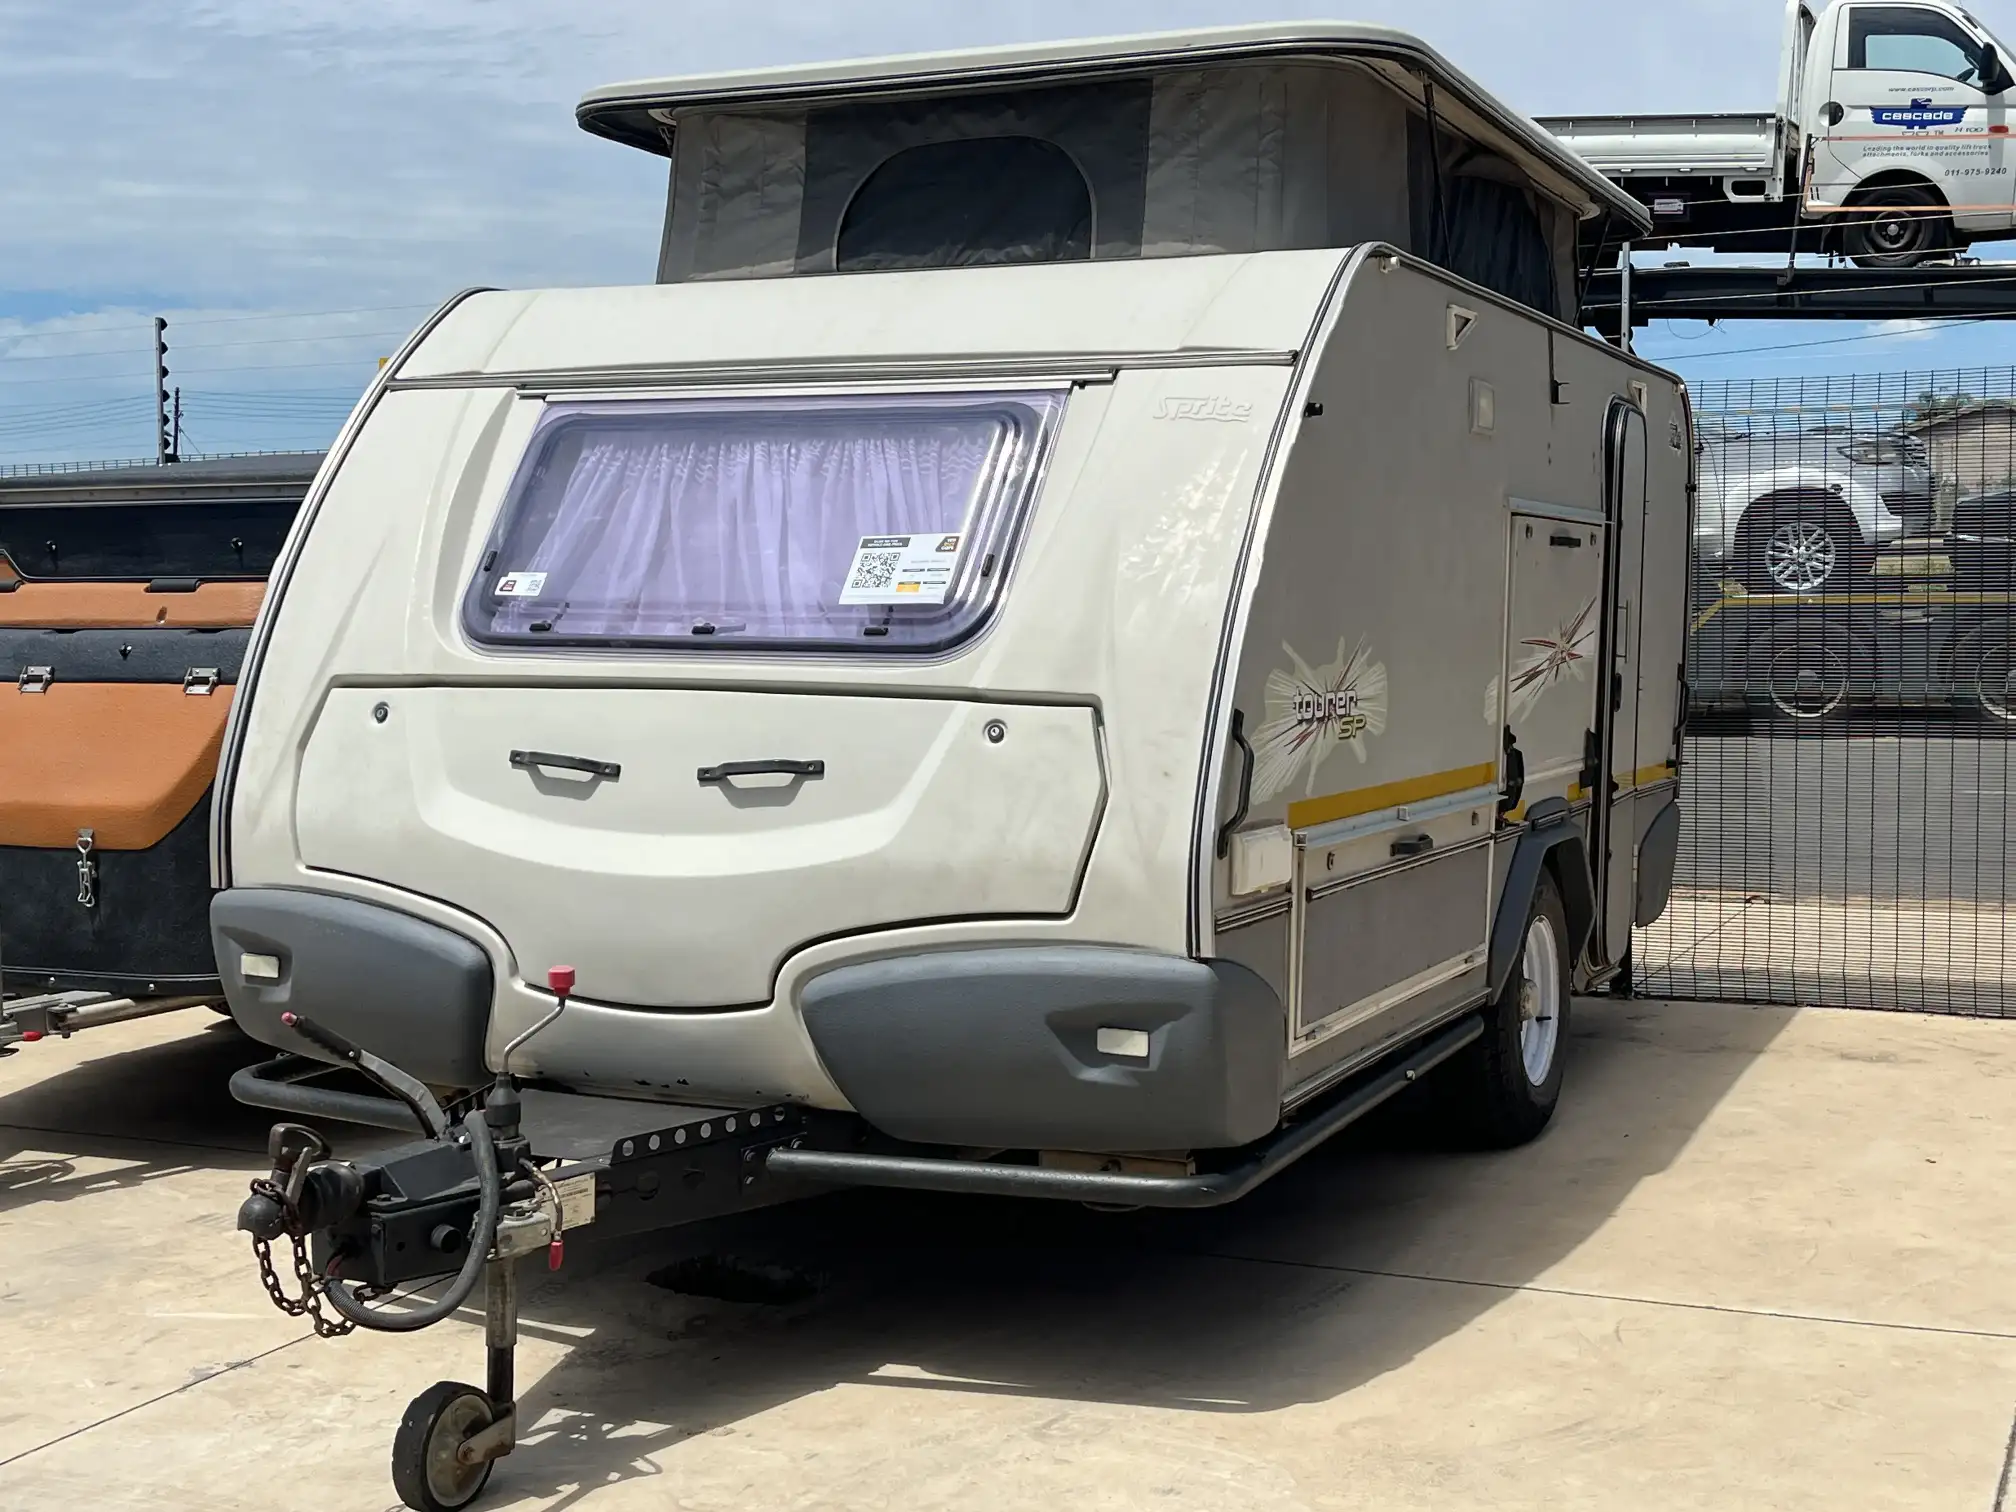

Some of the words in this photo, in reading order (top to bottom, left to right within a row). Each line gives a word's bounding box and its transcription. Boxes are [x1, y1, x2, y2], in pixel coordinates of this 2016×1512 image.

[1882, 111, 1954, 121] cascade
[1944, 167, 2007, 177] 011-975-9240
[1153, 394, 1253, 421] Sprite
[1293, 686, 1358, 722] tourer
[1338, 714, 1367, 740] SP
